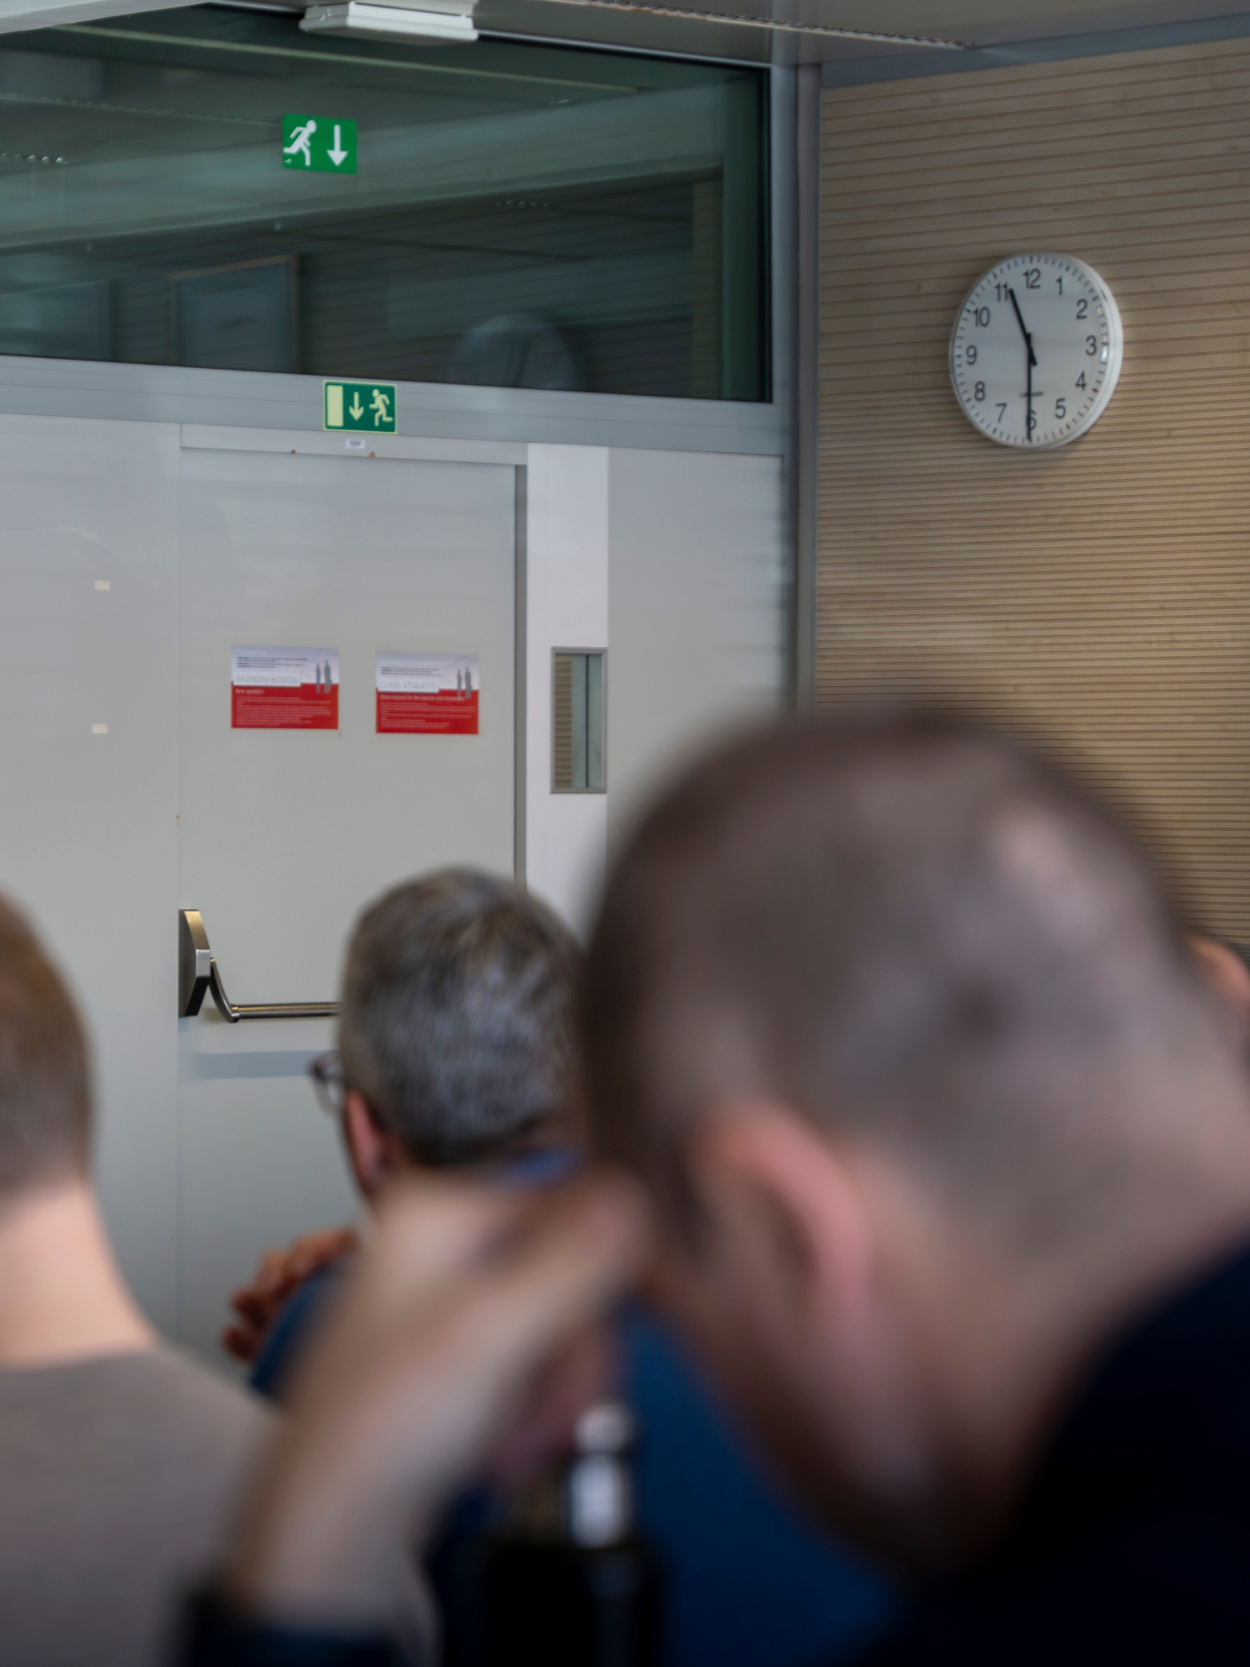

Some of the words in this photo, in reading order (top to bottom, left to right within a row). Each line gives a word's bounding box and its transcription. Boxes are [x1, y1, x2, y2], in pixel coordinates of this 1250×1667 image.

[1022, 268, 1041, 289] 12
[1055, 275, 1064, 295] 1
[994, 282, 1009, 302] 11
[972, 306, 990, 327] 10
[1076, 298, 1088, 320] 2
[965, 345, 978, 366] 9
[1085, 335, 1097, 356] 3
[974, 381, 986, 402] 8
[1075, 371, 1087, 391] 4
[995, 402, 1007, 423] 7
[1055, 398, 1066, 419] 5
